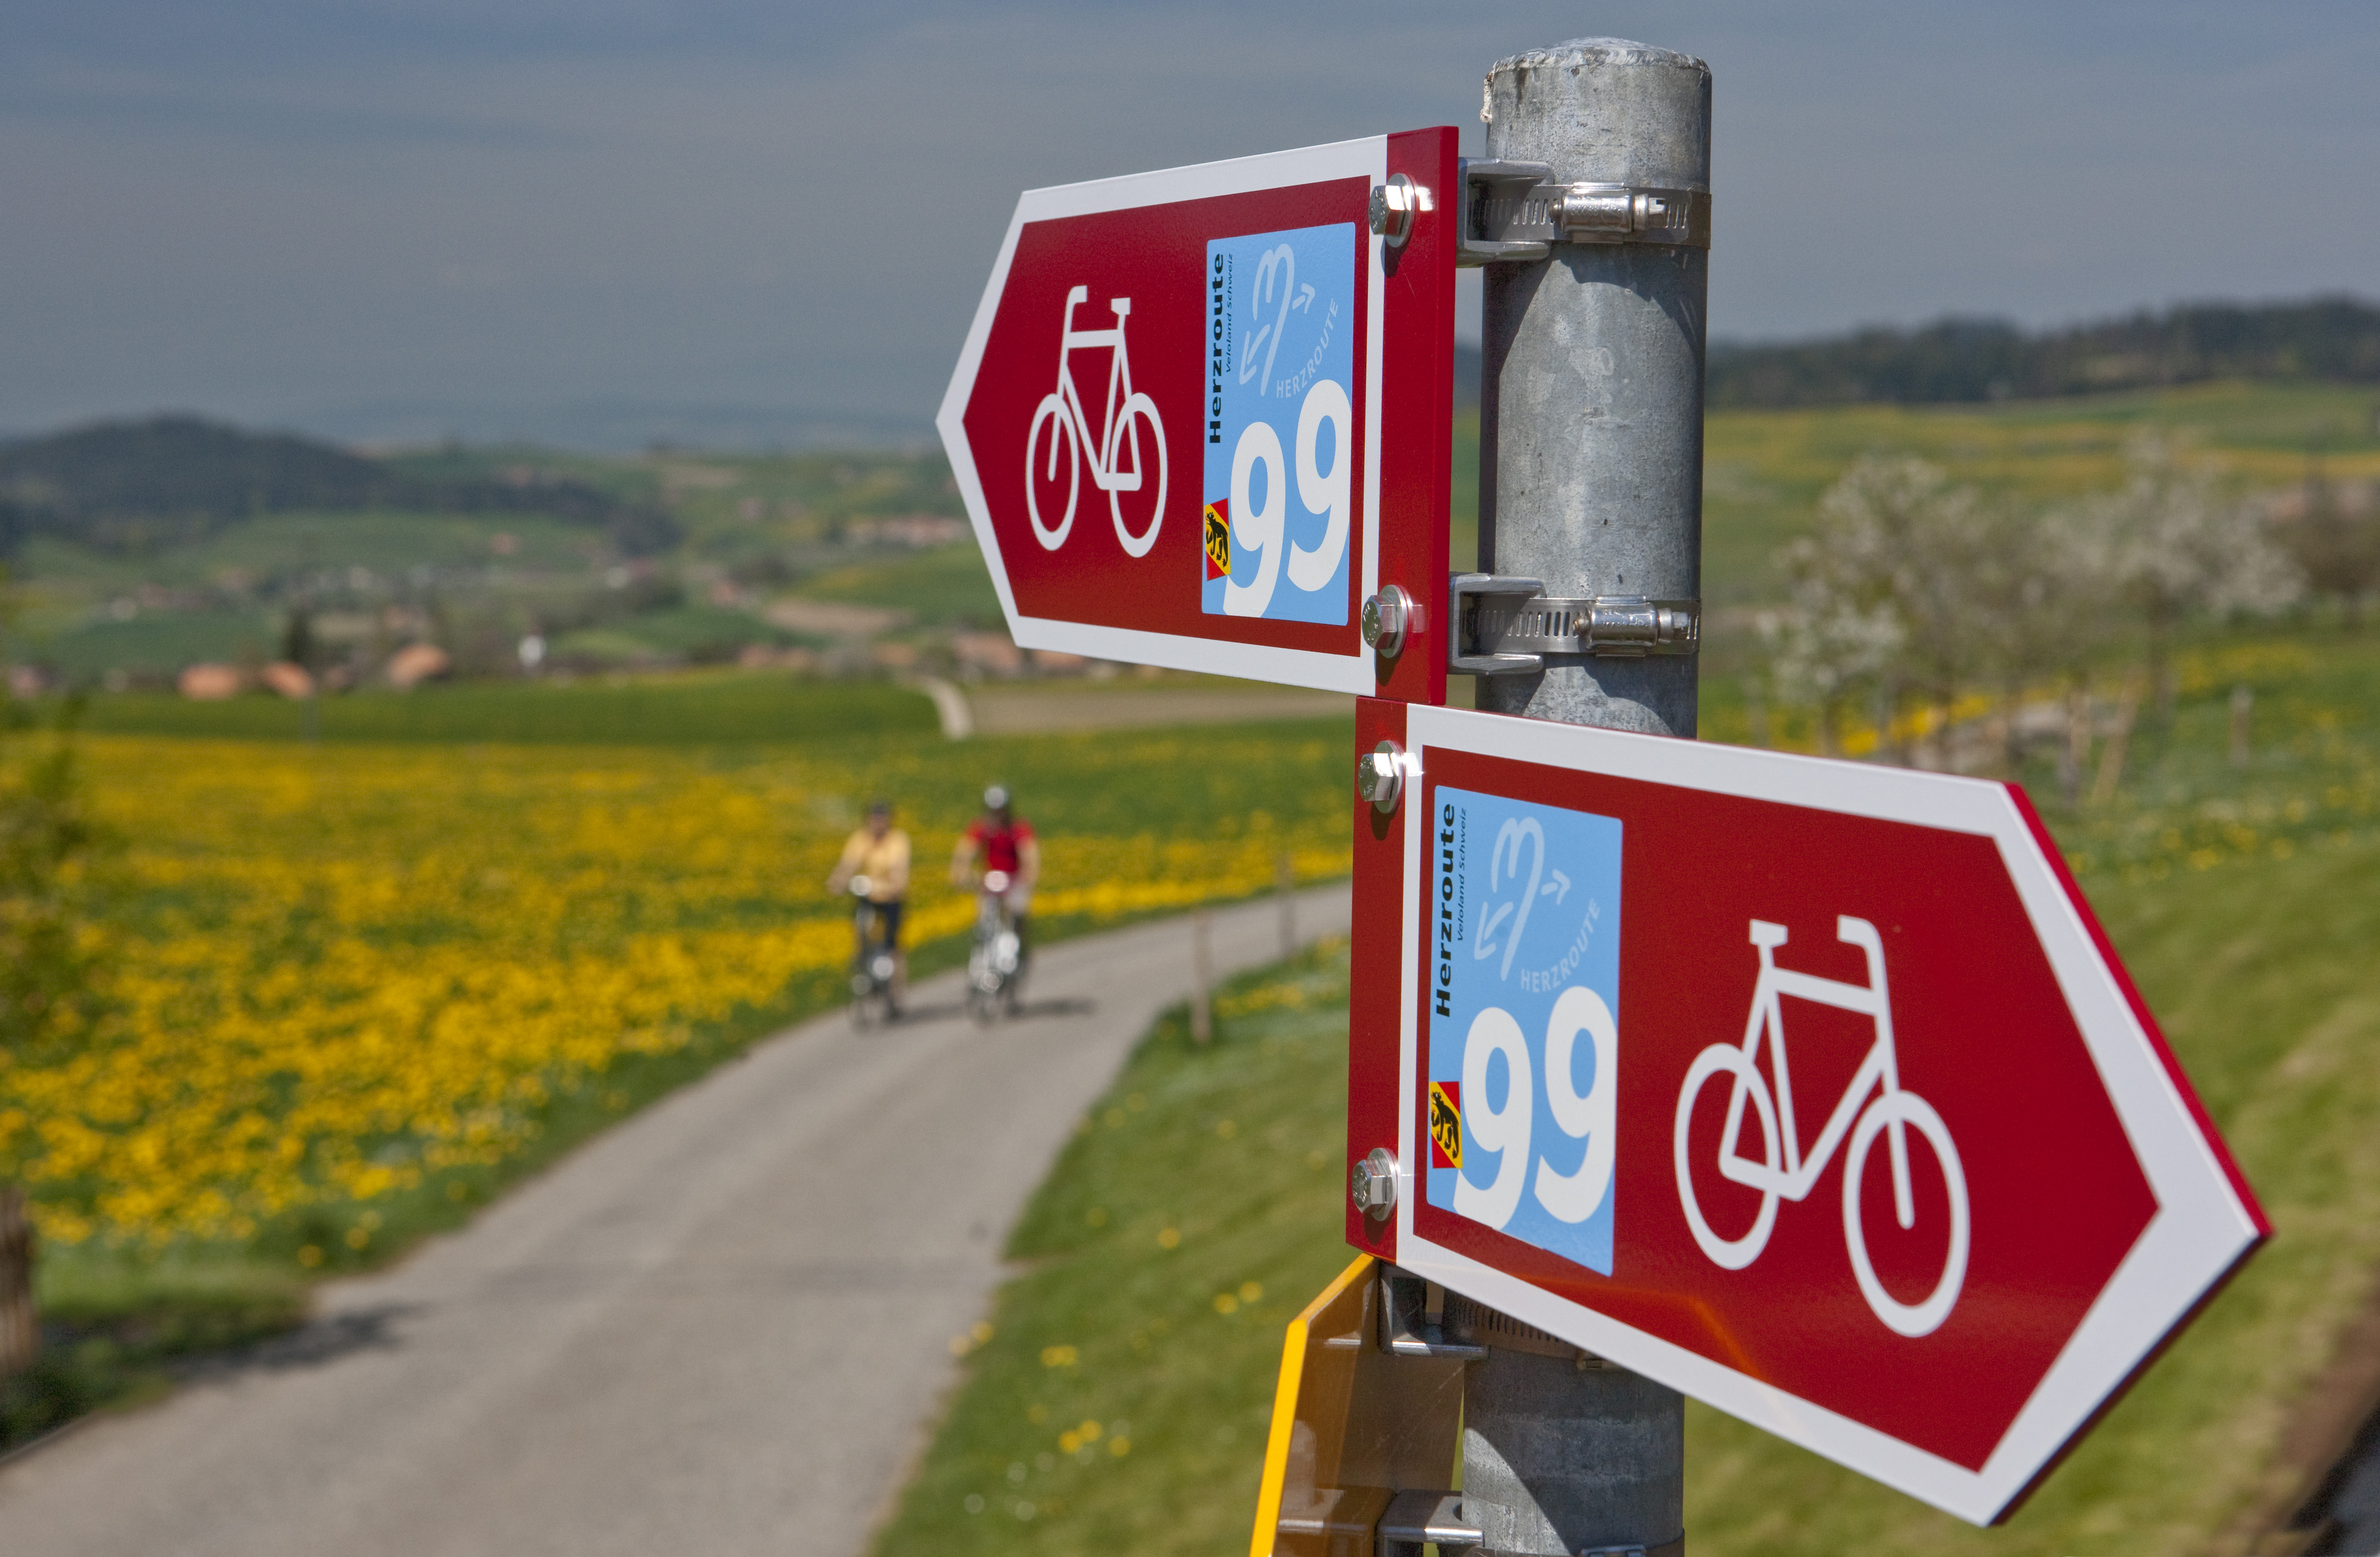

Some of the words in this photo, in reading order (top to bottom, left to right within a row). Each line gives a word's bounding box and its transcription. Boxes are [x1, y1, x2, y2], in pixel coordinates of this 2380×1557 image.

[1209, 254, 1223, 443] Herzroute
[1276, 298, 1338, 399] HERZROUTE
[1222, 379, 1352, 618] 99
[1436, 804, 1455, 1017] Herzroute
[1459, 808, 1467, 871] Schweiz
[1521, 897, 1601, 993] HERZROUTE
[1453, 985, 1618, 1231] 99
